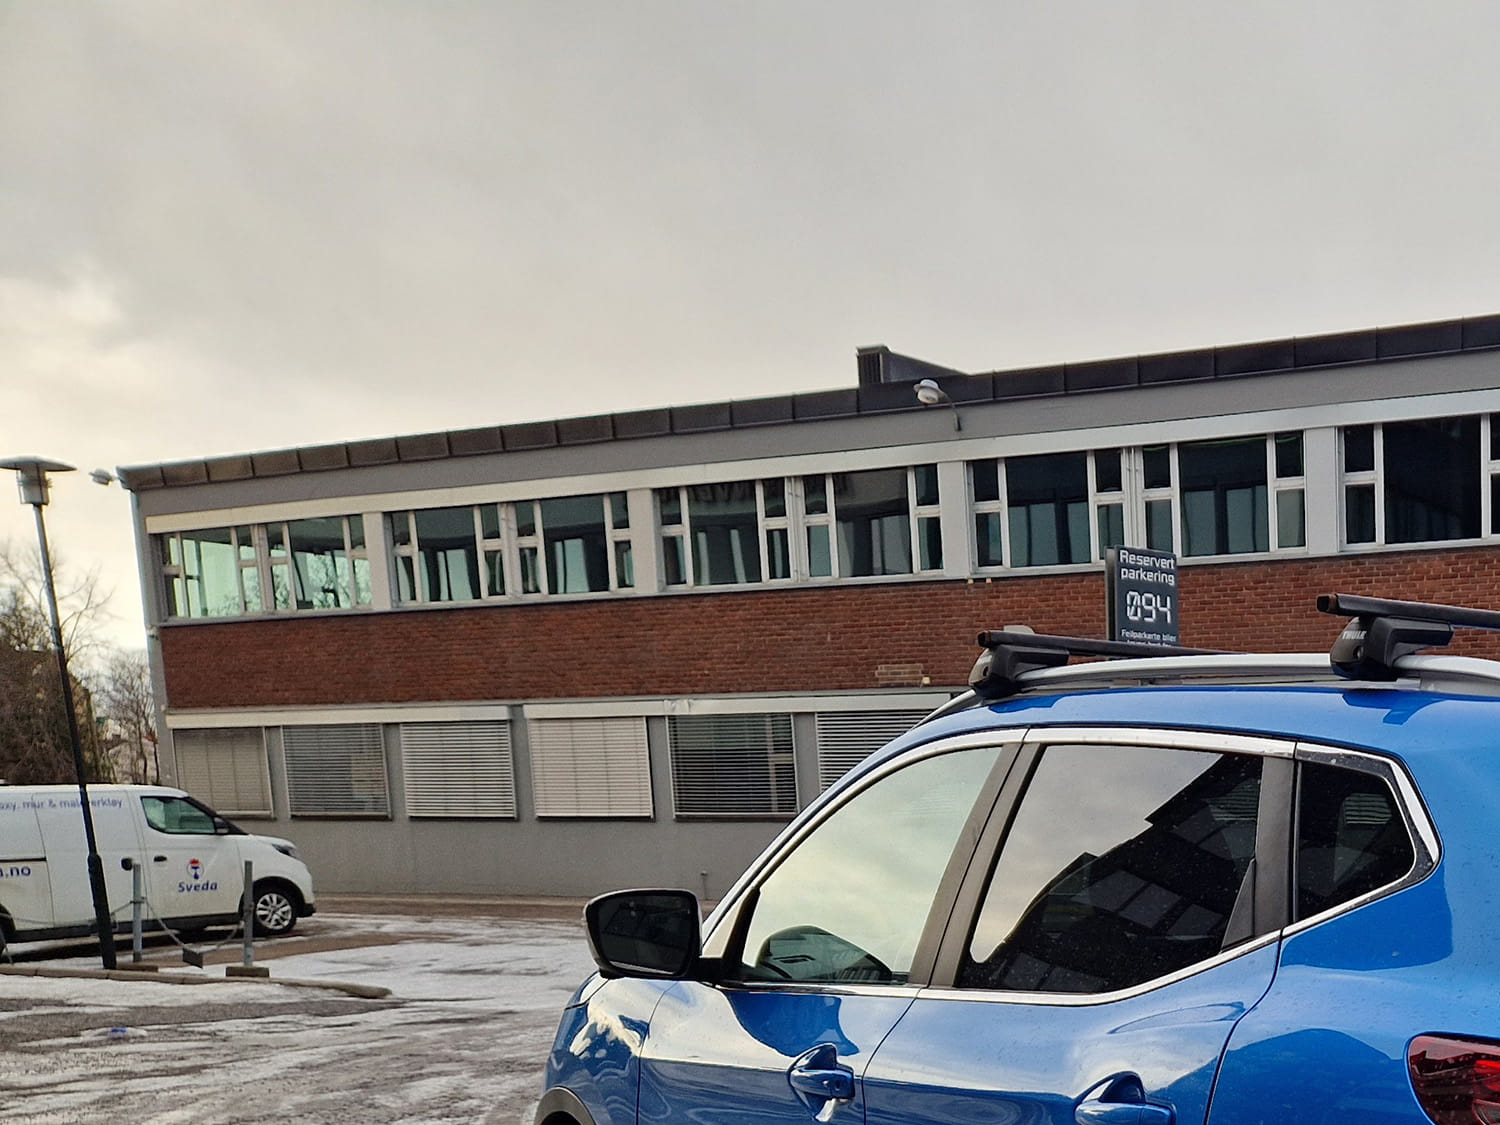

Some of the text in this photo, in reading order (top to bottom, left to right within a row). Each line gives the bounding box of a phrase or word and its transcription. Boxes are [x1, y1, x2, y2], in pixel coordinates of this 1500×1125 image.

[1120, 550, 1175, 570] Reservert
[1121, 568, 1175, 586] parkering
[1126, 591, 1171, 624] 094
[1341, 630, 1368, 640] THULE
[178, 880, 218, 893] Sveda
